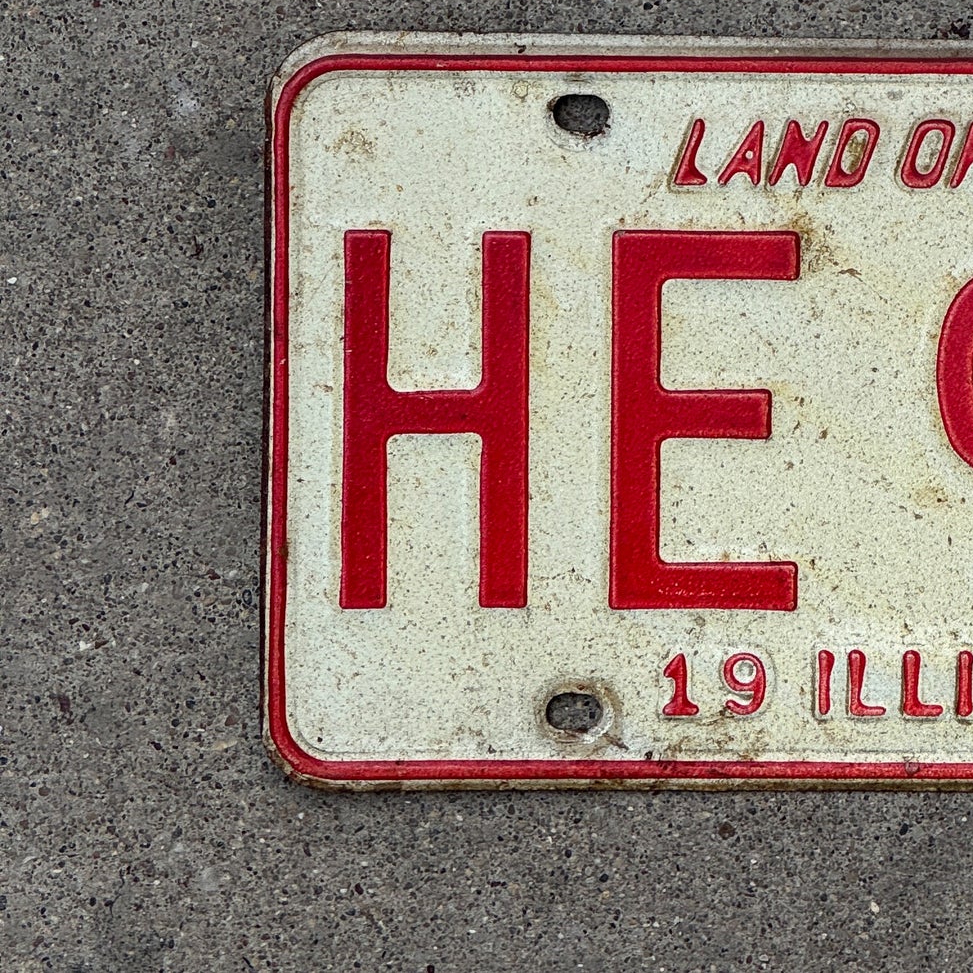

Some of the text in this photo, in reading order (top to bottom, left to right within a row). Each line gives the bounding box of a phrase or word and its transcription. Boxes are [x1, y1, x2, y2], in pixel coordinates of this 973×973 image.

[673, 117, 881, 189] LAND
[338, 228, 802, 613] HE
[662, 652, 768, 717] 19
